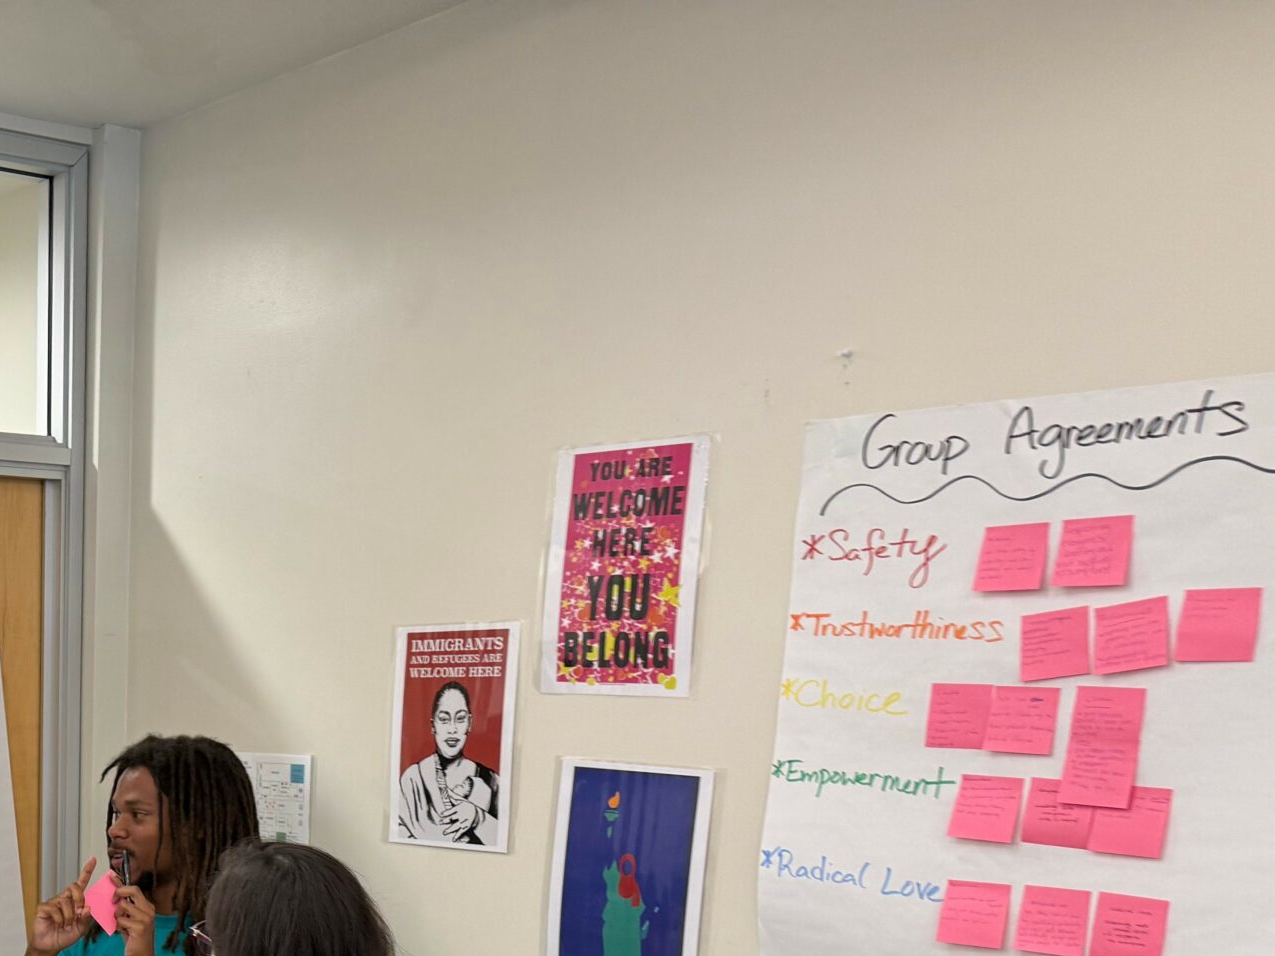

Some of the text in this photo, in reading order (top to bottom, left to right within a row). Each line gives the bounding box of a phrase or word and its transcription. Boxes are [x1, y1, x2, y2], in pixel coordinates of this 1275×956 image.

[862, 389, 1249, 480] Group Agreements
[590, 456, 673, 482] YOU ARE
[573, 485, 686, 520] WELCOME
[591, 527, 654, 557] HERE
[824, 528, 948, 589] Safety
[587, 573, 651, 621] YOU
[808, 611, 1004, 643] Trustworthiness
[410, 653, 503, 665] AND REFUGEES ARE
[411, 637, 504, 653] IMMIGRANTS
[564, 631, 670, 669] BELONG
[409, 665, 502, 679] WELCOME HERE
[794, 680, 909, 716] Choice
[785, 760, 956, 799] Empowerment
[777, 848, 870, 889] Radical
[881, 867, 945, 902] Love
